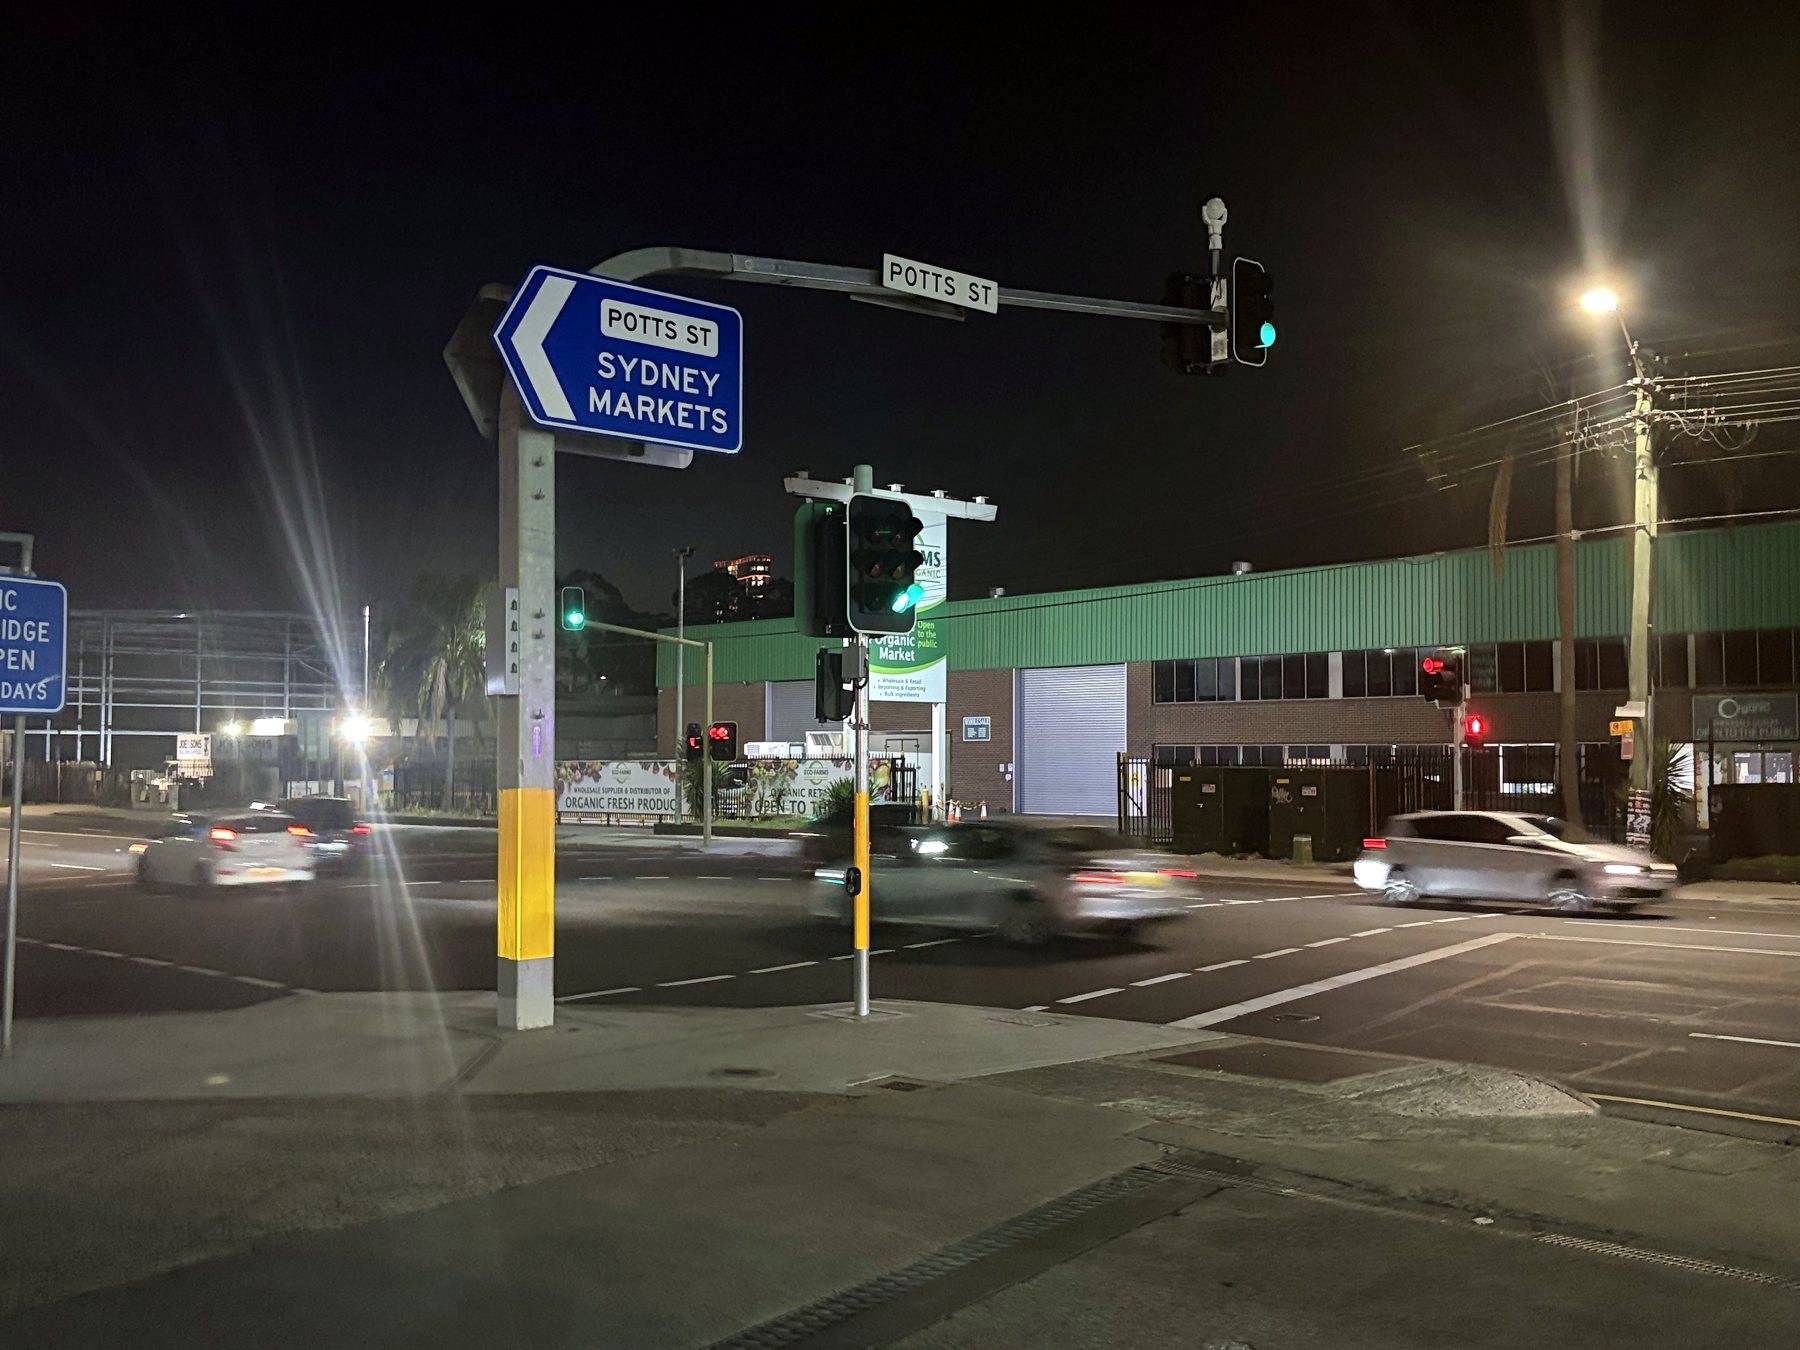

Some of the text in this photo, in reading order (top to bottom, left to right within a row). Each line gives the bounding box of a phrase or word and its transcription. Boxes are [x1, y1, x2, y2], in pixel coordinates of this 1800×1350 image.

[890, 261, 992, 305] POTTS ST
[608, 308, 712, 347] POTTS ST
[597, 351, 721, 397] SYDNEY
[589, 386, 729, 434] MARKETS
[915, 570, 941, 579] GANIC
[2, 619, 50, 643] IDGE
[917, 620, 935, 630] Open
[874, 634, 916, 647] Organic
[917, 630, 937, 639] to the
[917, 639, 938, 649] public
[879, 646, 916, 661] Market
[1, 681, 47, 700] DAYS
[573, 786, 601, 794] WHOLESALE
[602, 786, 623, 794] SUPPLIER
[629, 787, 662, 795] DISTRIBUTOR
[663, 787, 670, 795] OF
[770, 788, 806, 799] OANIC
[565, 796, 677, 811] ORGANIC FRESH PRODUC
[789, 800, 806, 815] TO
[810, 802, 829, 818] TH
